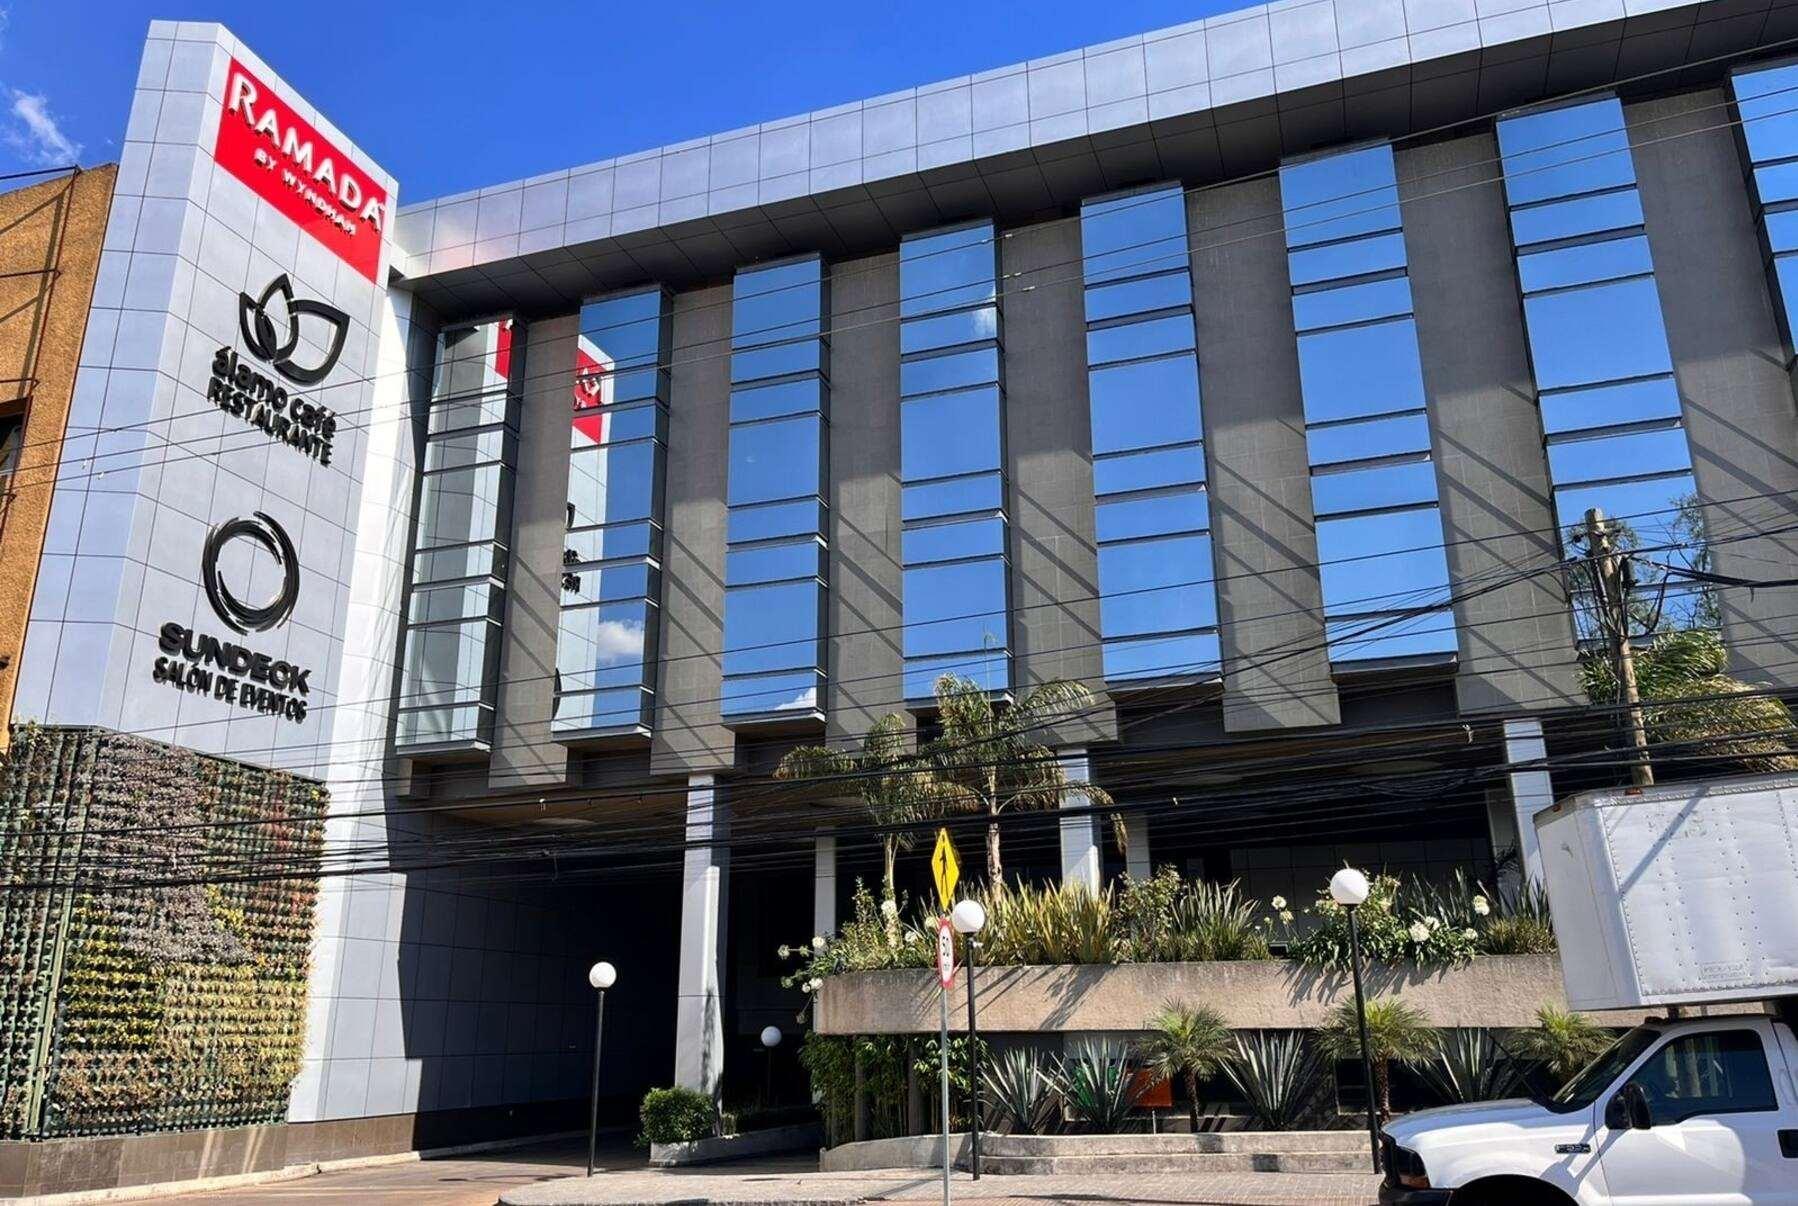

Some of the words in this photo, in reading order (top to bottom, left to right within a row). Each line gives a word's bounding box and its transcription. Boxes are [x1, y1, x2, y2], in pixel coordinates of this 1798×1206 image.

[228, 72, 383, 232] RAMADA
[254, 147, 277, 173] BY
[282, 168, 357, 237] WYNDHAM
[207, 376, 333, 467] RESTAURANTE
[290, 397, 337, 441] café
[159, 622, 312, 697] SUNDECK
[214, 675, 239, 705] DE
[239, 682, 308, 724] EVENTOS
